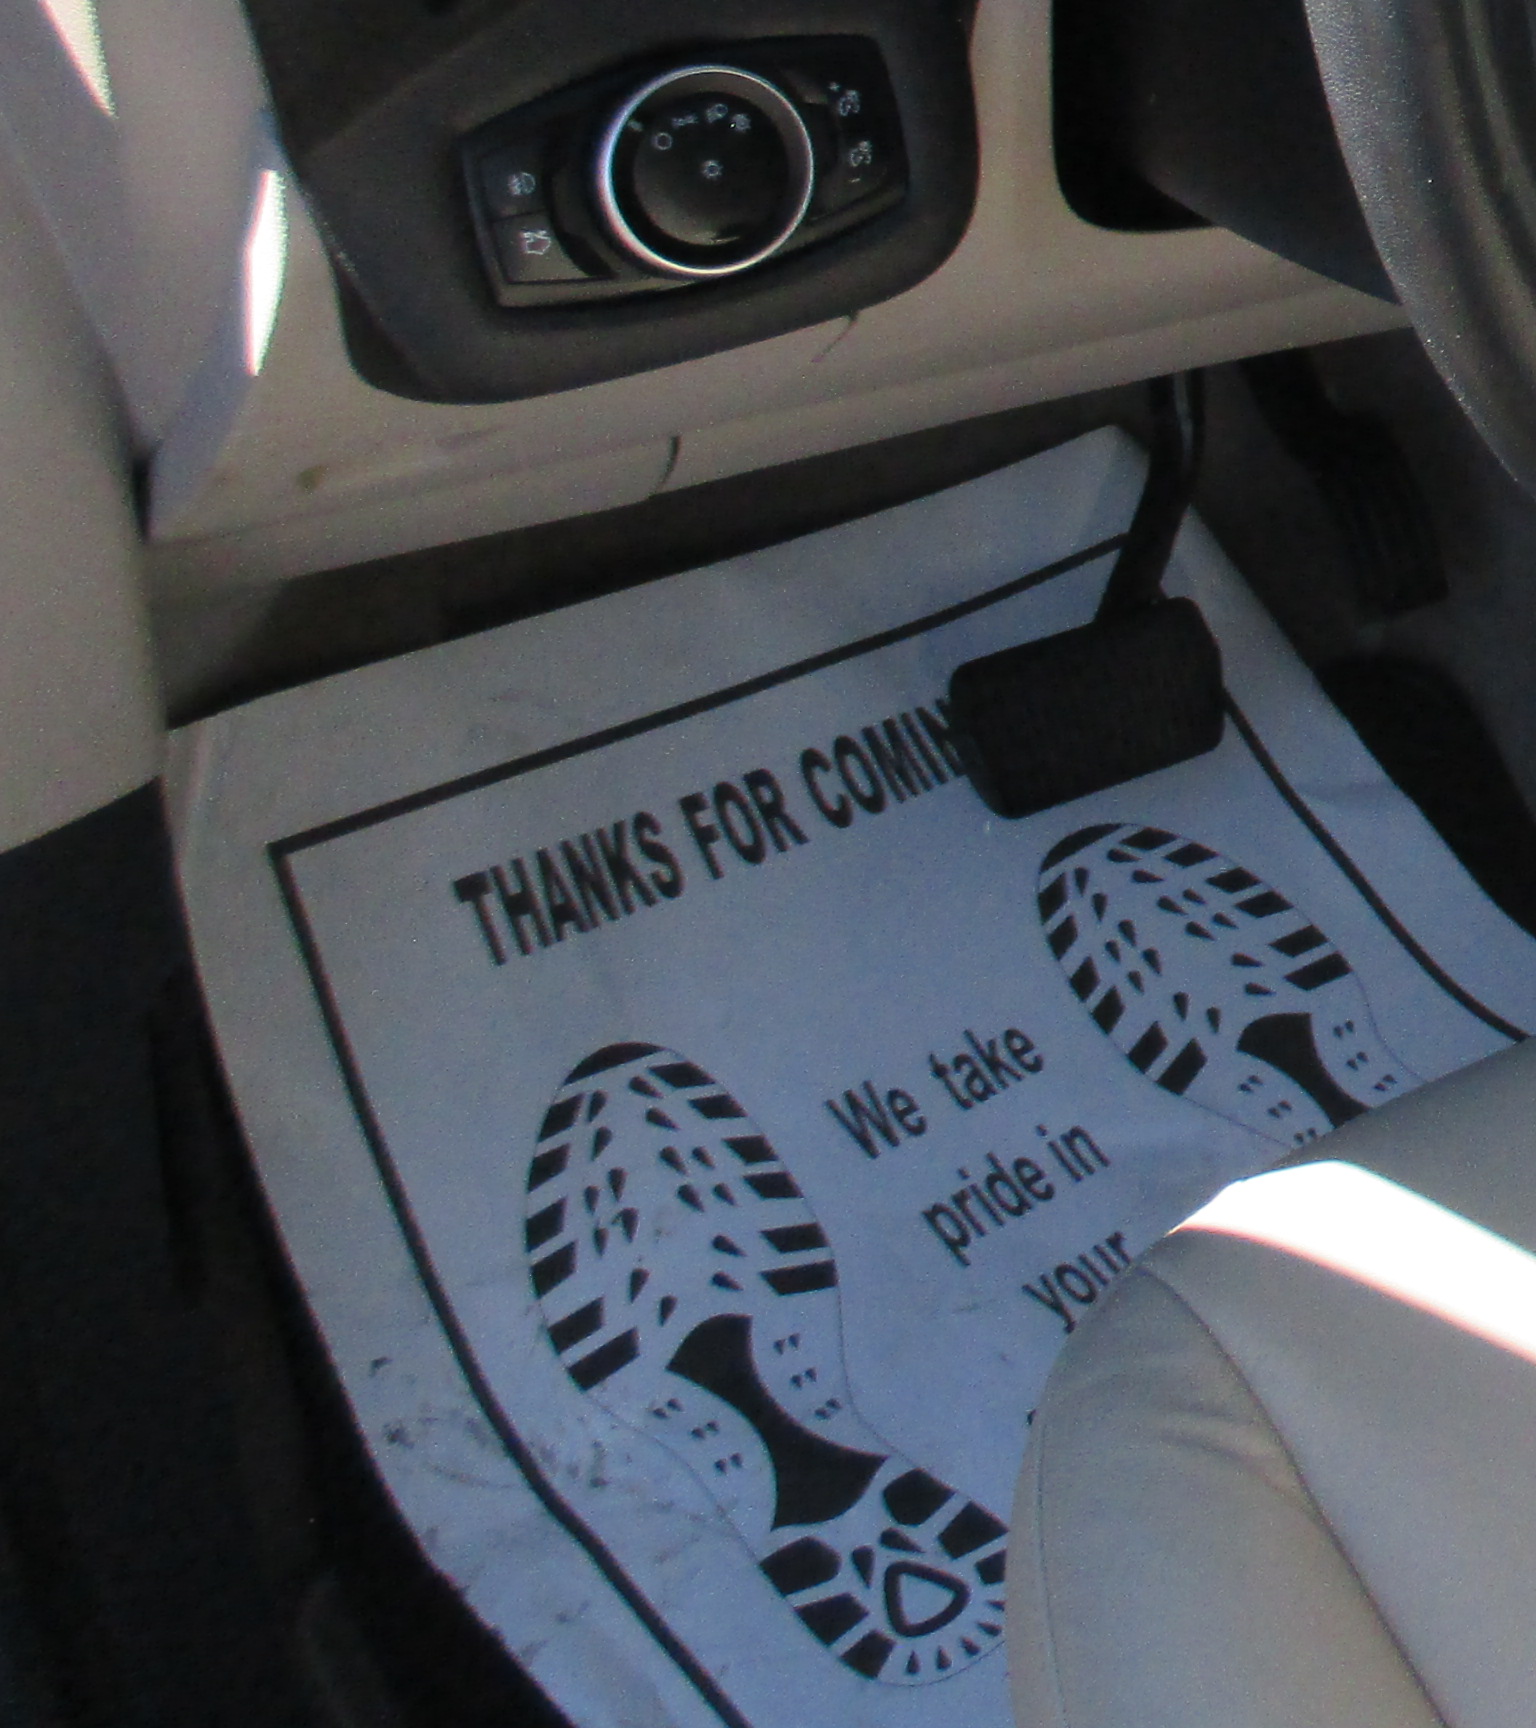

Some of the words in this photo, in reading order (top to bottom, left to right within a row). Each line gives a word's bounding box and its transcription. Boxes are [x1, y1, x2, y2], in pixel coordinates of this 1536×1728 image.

[452, 810, 686, 966] THANKS
[678, 768, 809, 880] FOR
[801, 698, 967, 829] COMIN
[824, 1080, 928, 1159] We
[930, 1028, 1044, 1110] take
[921, 1152, 1056, 1267] pride
[1036, 1124, 1111, 1182] in
